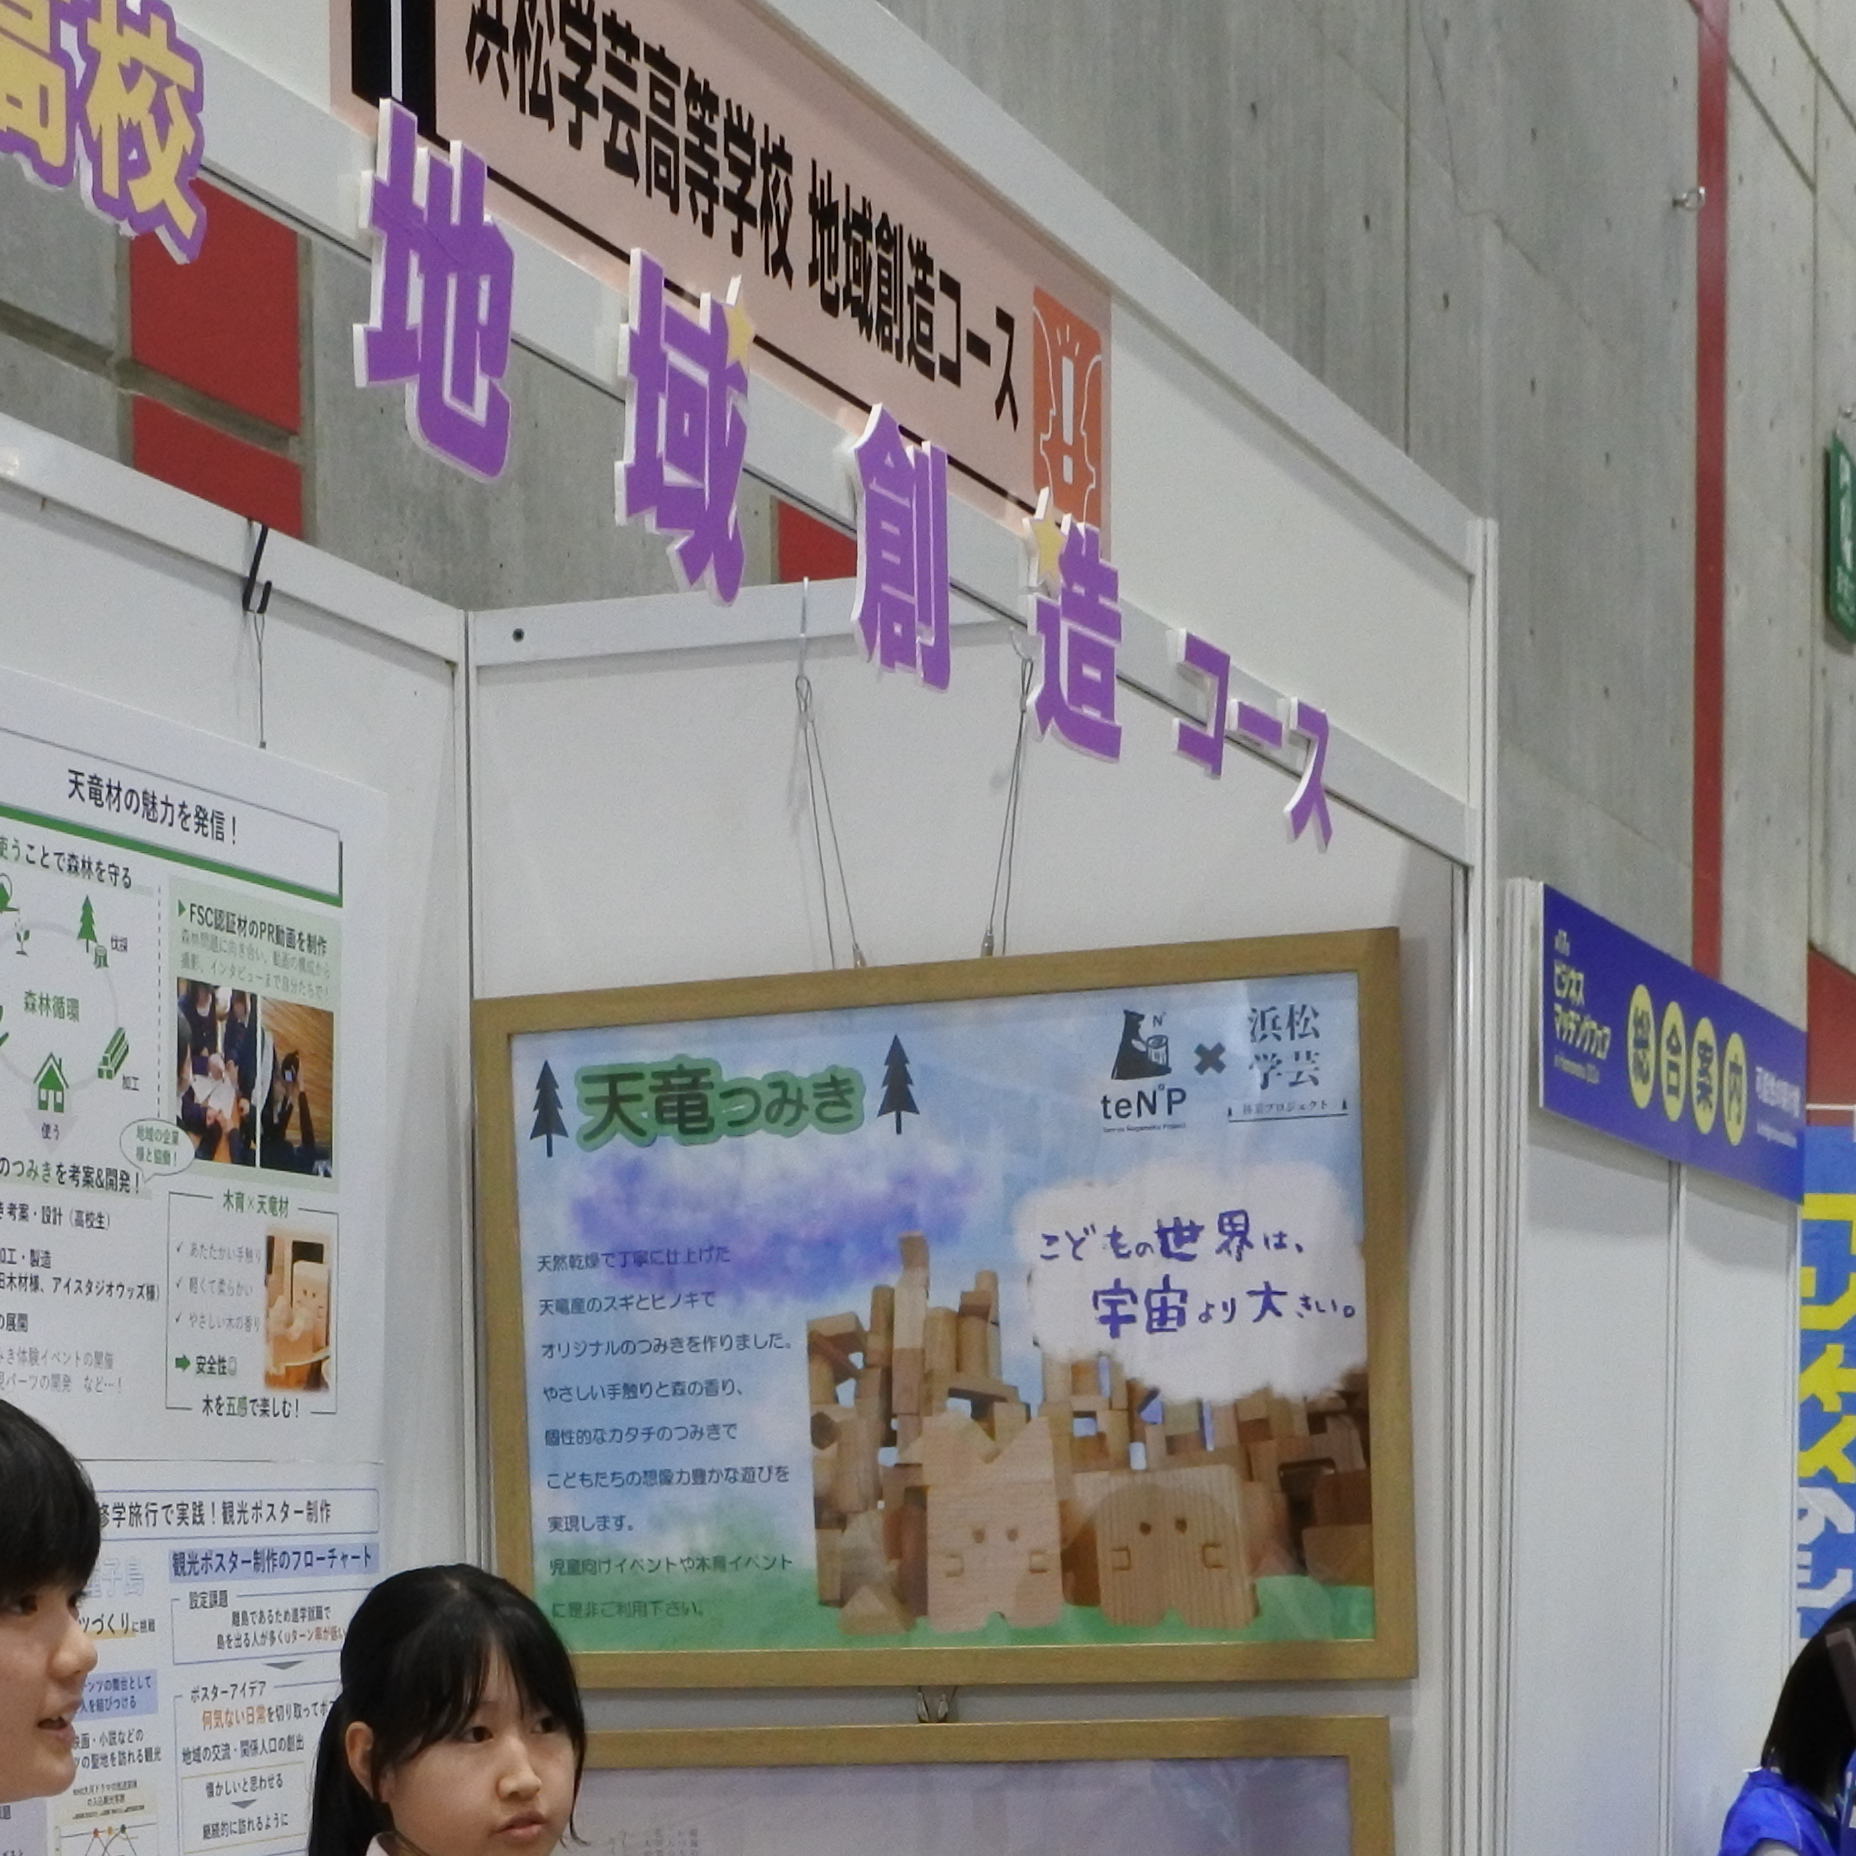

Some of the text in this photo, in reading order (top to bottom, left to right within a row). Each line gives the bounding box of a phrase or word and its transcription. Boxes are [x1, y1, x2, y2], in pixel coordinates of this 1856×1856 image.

[808, 160, 1017, 433] 地域創造コース
[68, 769, 238, 844] 天竜材の魅力を発信！
[1248, 1004, 1320, 1043] 浜松
[580, 1062, 856, 1143] 天竜つみき
[1248, 1050, 1320, 1091] 学芸
